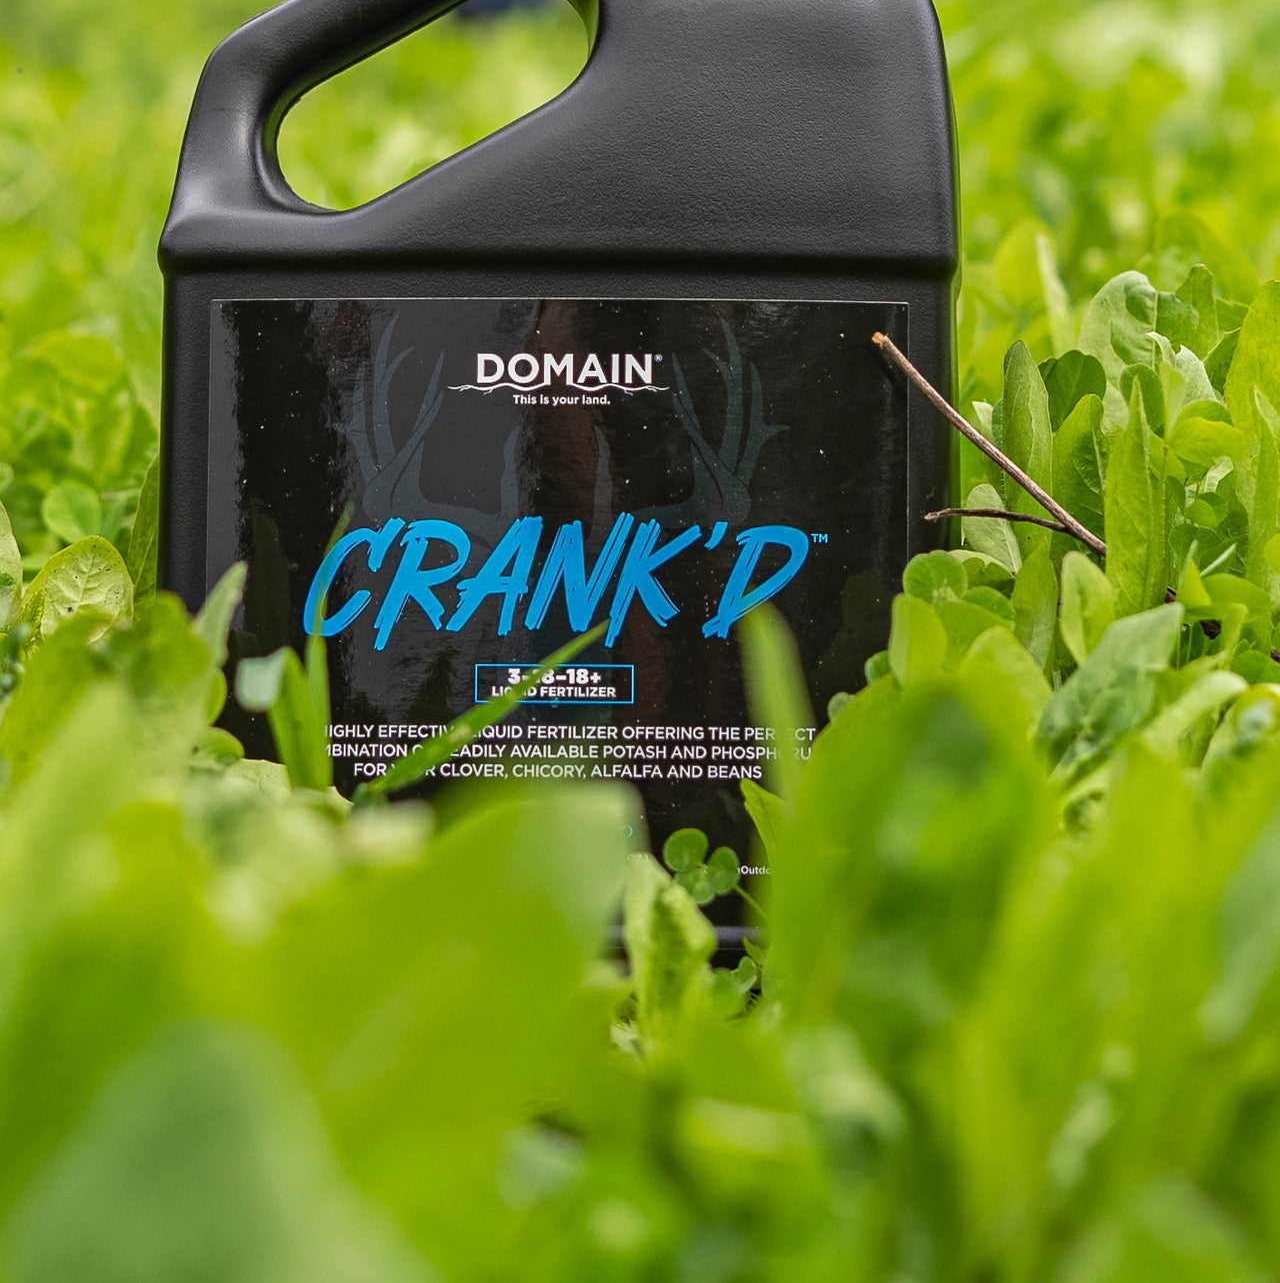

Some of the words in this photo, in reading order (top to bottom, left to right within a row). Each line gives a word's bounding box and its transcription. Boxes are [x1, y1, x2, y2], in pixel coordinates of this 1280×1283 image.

[513, 395, 537, 405] This
[540, 395, 549, 405] is
[552, 396, 579, 407] your
[582, 395, 611, 405] land.
[492, 686, 537, 697] LIQID
[540, 686, 616, 697] FERTILIZER
[378, 725, 455, 738] EFFECTIV
[472, 725, 523, 740] IQUID
[527, 725, 617, 740] FERTILIZER
[622, 726, 704, 740] OFFERING
[708, 726, 740, 740] THE
[744, 727, 816, 741] PERCT
[325, 744, 407, 757] BINATION
[450, 744, 506, 758] ADILY
[510, 744, 598, 759] AVAILABLE
[603, 745, 667, 759] POTASH
[671, 746, 706, 759] AND
[354, 763, 387, 776] FOR
[440, 763, 508, 779] CLOVER,
[512, 764, 586, 779] CHICORY,
[590, 764, 662, 778] ALFALFA
[667, 765, 703, 778] AND
[708, 765, 762, 779] BEANS
